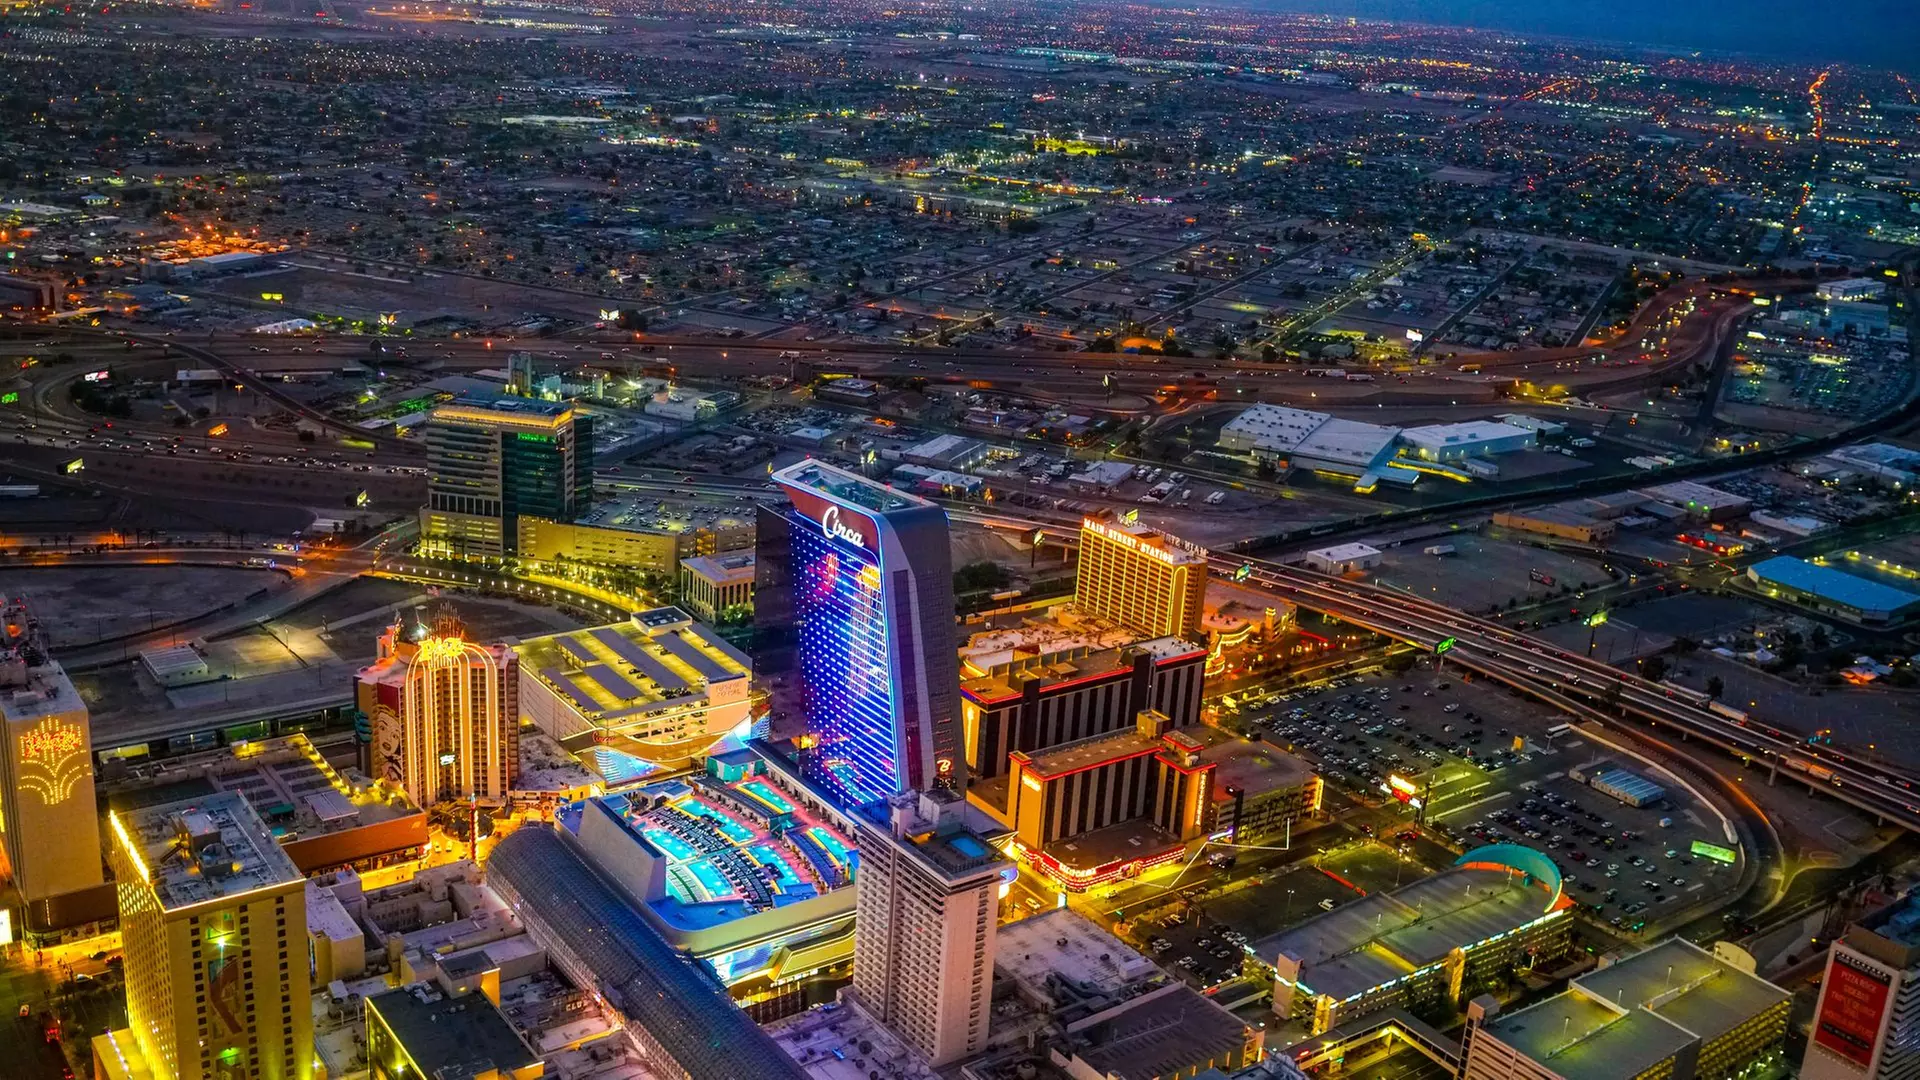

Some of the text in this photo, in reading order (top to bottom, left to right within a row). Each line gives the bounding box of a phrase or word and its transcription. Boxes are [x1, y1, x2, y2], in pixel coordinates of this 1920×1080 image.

[822, 505, 864, 547] Circa
[1083, 517, 1174, 564] MAIN STREET STATION
